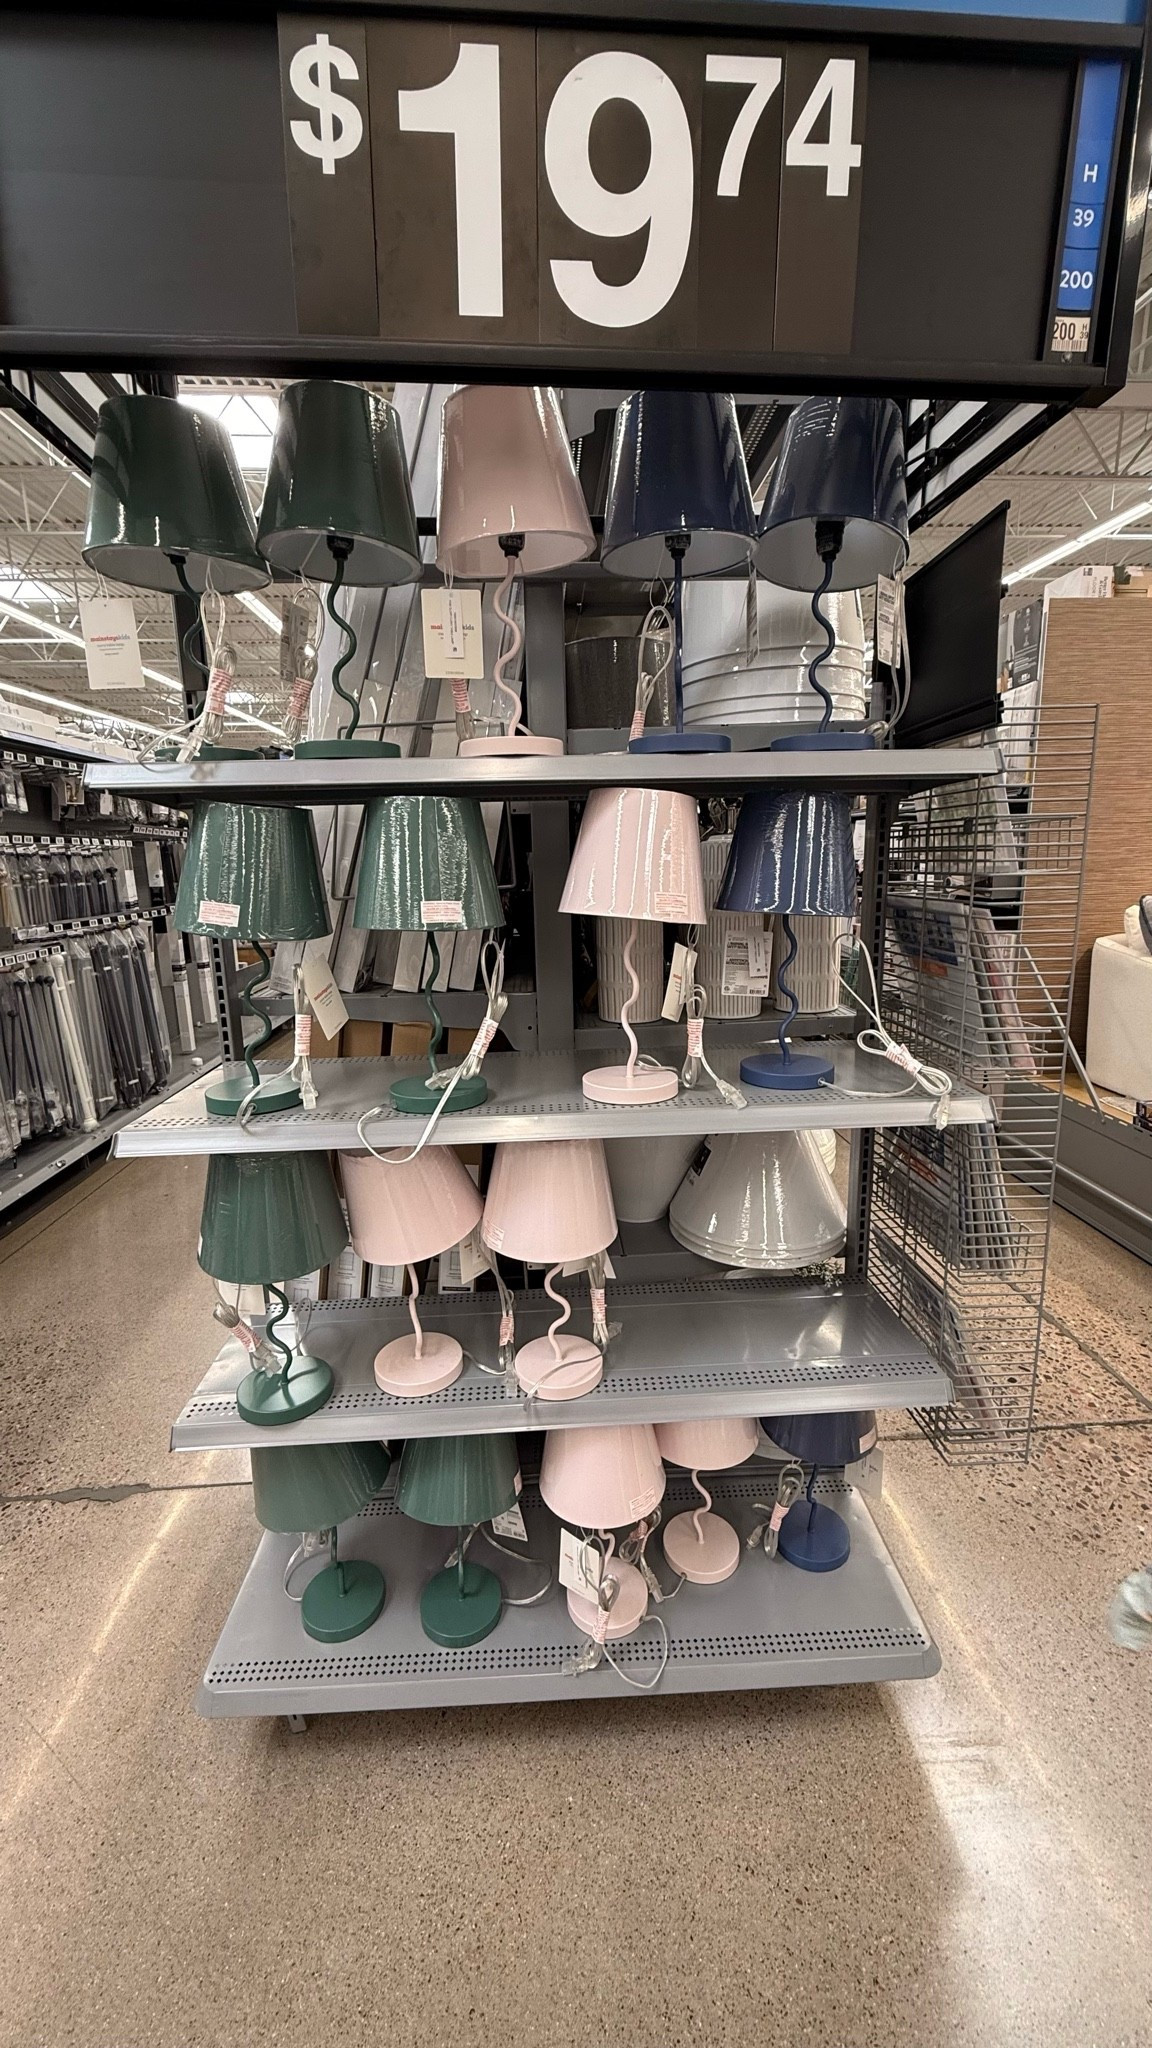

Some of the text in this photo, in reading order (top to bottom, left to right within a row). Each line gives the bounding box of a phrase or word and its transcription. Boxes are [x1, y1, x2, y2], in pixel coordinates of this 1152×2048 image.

[289, 33, 863, 328] $ 19 74
[1083, 163, 1098, 183] H
[1072, 208, 1095, 228] 39
[1059, 269, 1094, 290] 200
[1052, 322, 1076, 340] 200
